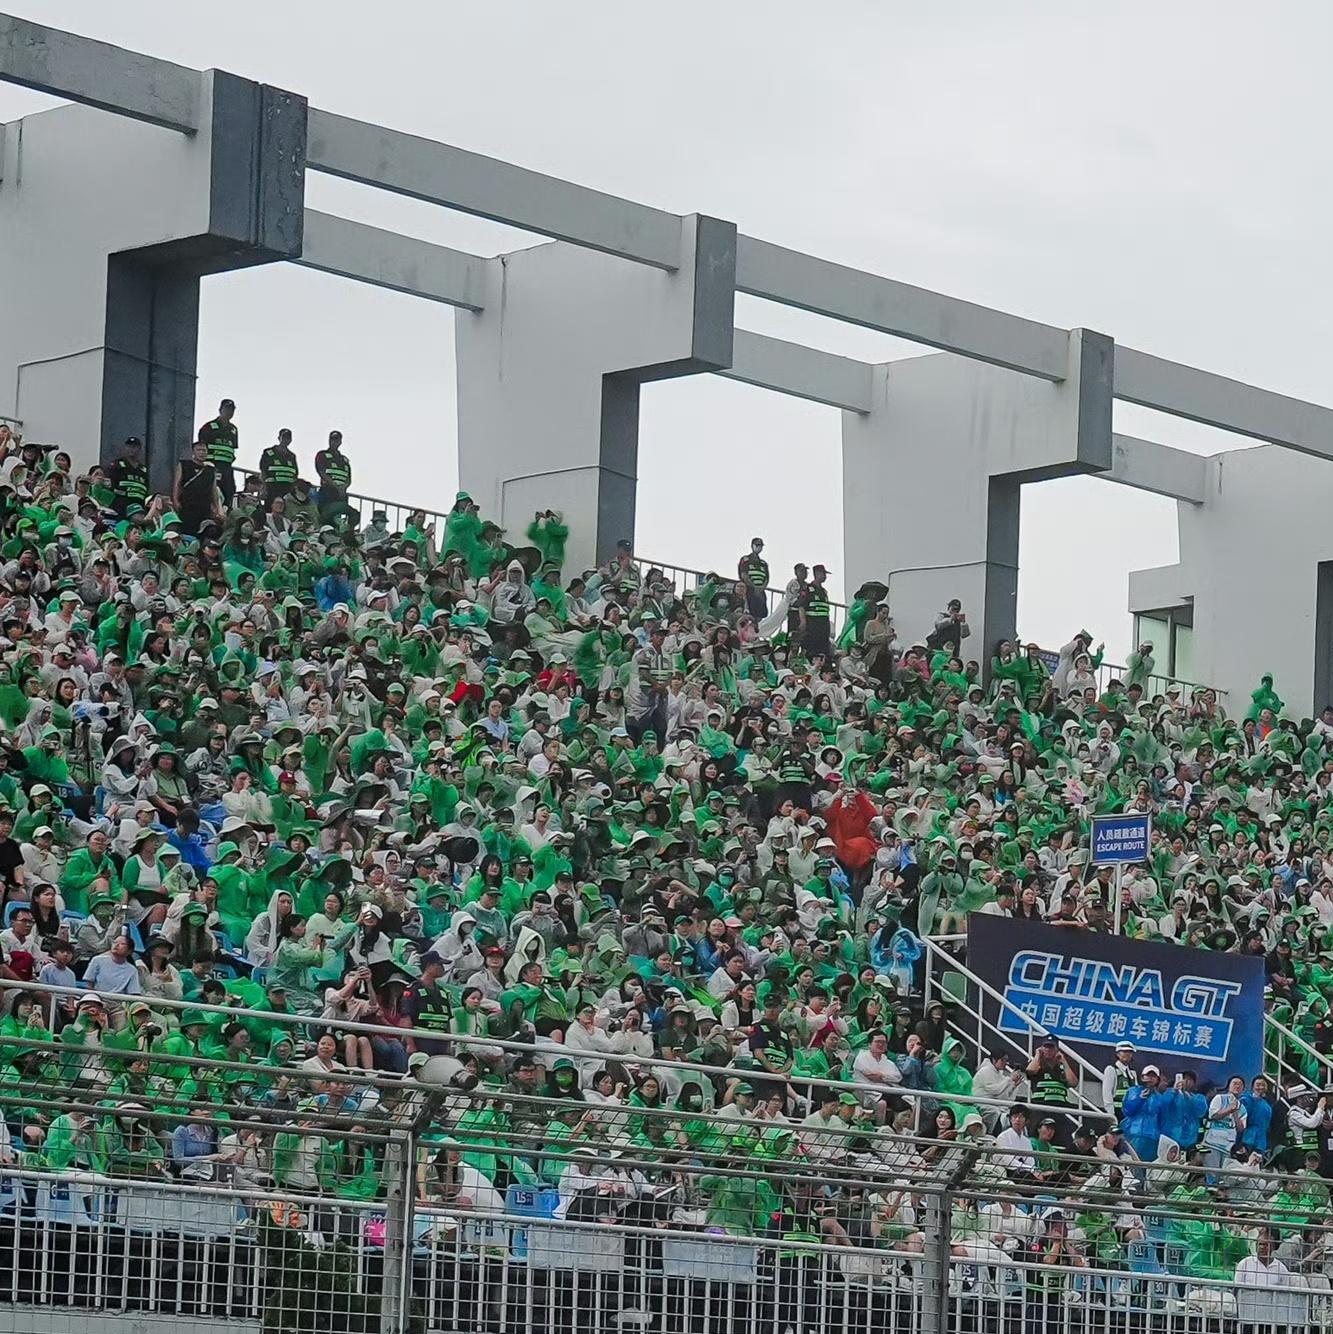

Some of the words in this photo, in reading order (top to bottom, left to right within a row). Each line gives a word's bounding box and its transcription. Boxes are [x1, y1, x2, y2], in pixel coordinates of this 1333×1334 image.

[1097, 843, 1122, 852] ESCAPE
[1123, 841, 1145, 850] ROUTE
[1008, 950, 1166, 1012] CHINA
[1171, 975, 1242, 1018] GT
[1019, 1000, 1214, 1050] 中国超级跑车锦标赛
